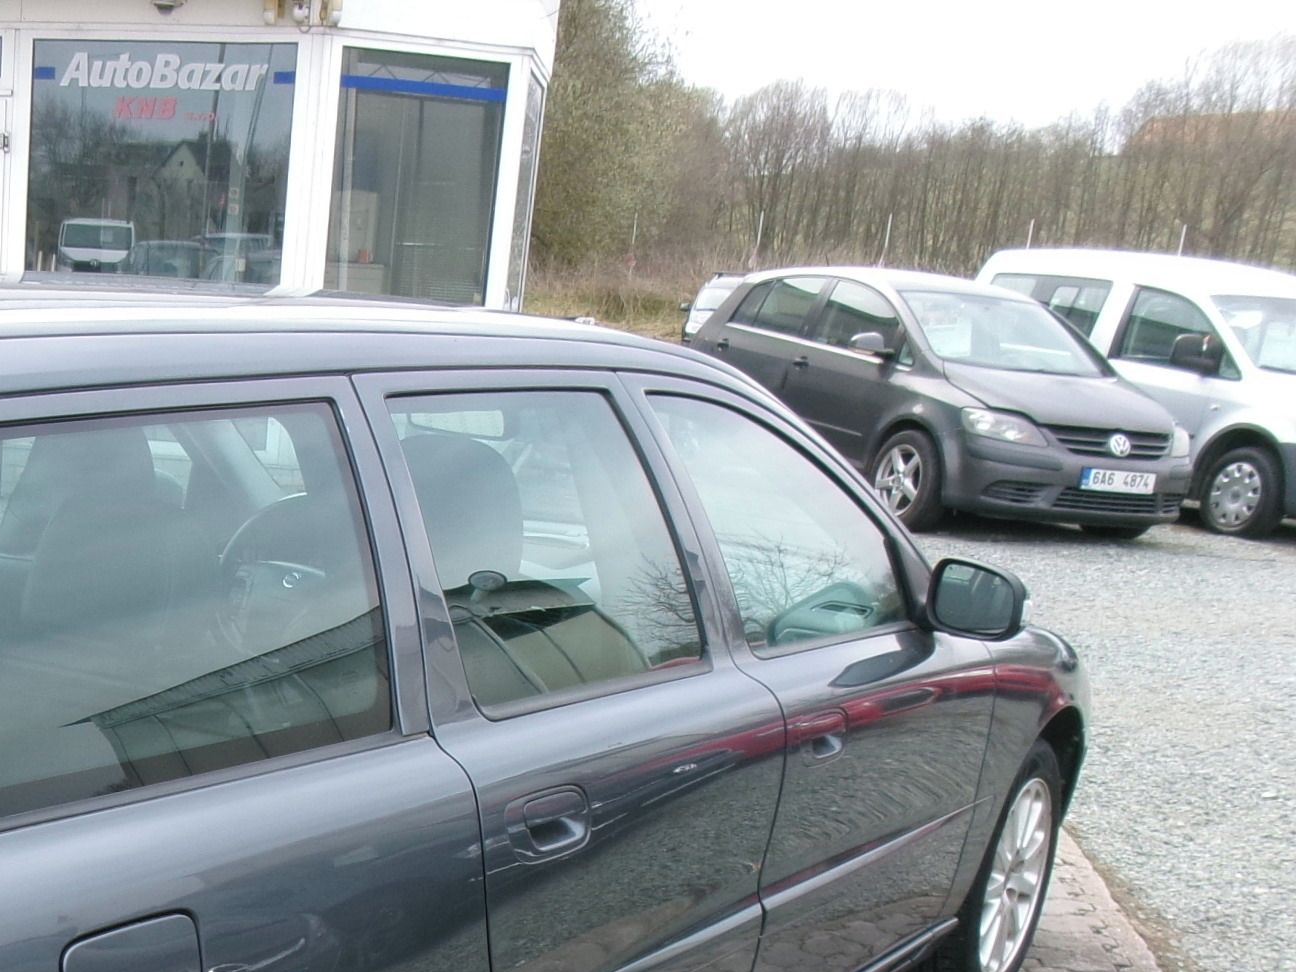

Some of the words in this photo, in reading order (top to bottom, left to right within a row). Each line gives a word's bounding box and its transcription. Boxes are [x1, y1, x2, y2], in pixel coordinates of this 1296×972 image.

[60, 52, 268, 91] AutoBazar
[115, 96, 178, 120] KNB
[1092, 471, 1115, 486] 6A6
[1122, 473, 1150, 488] 4874
